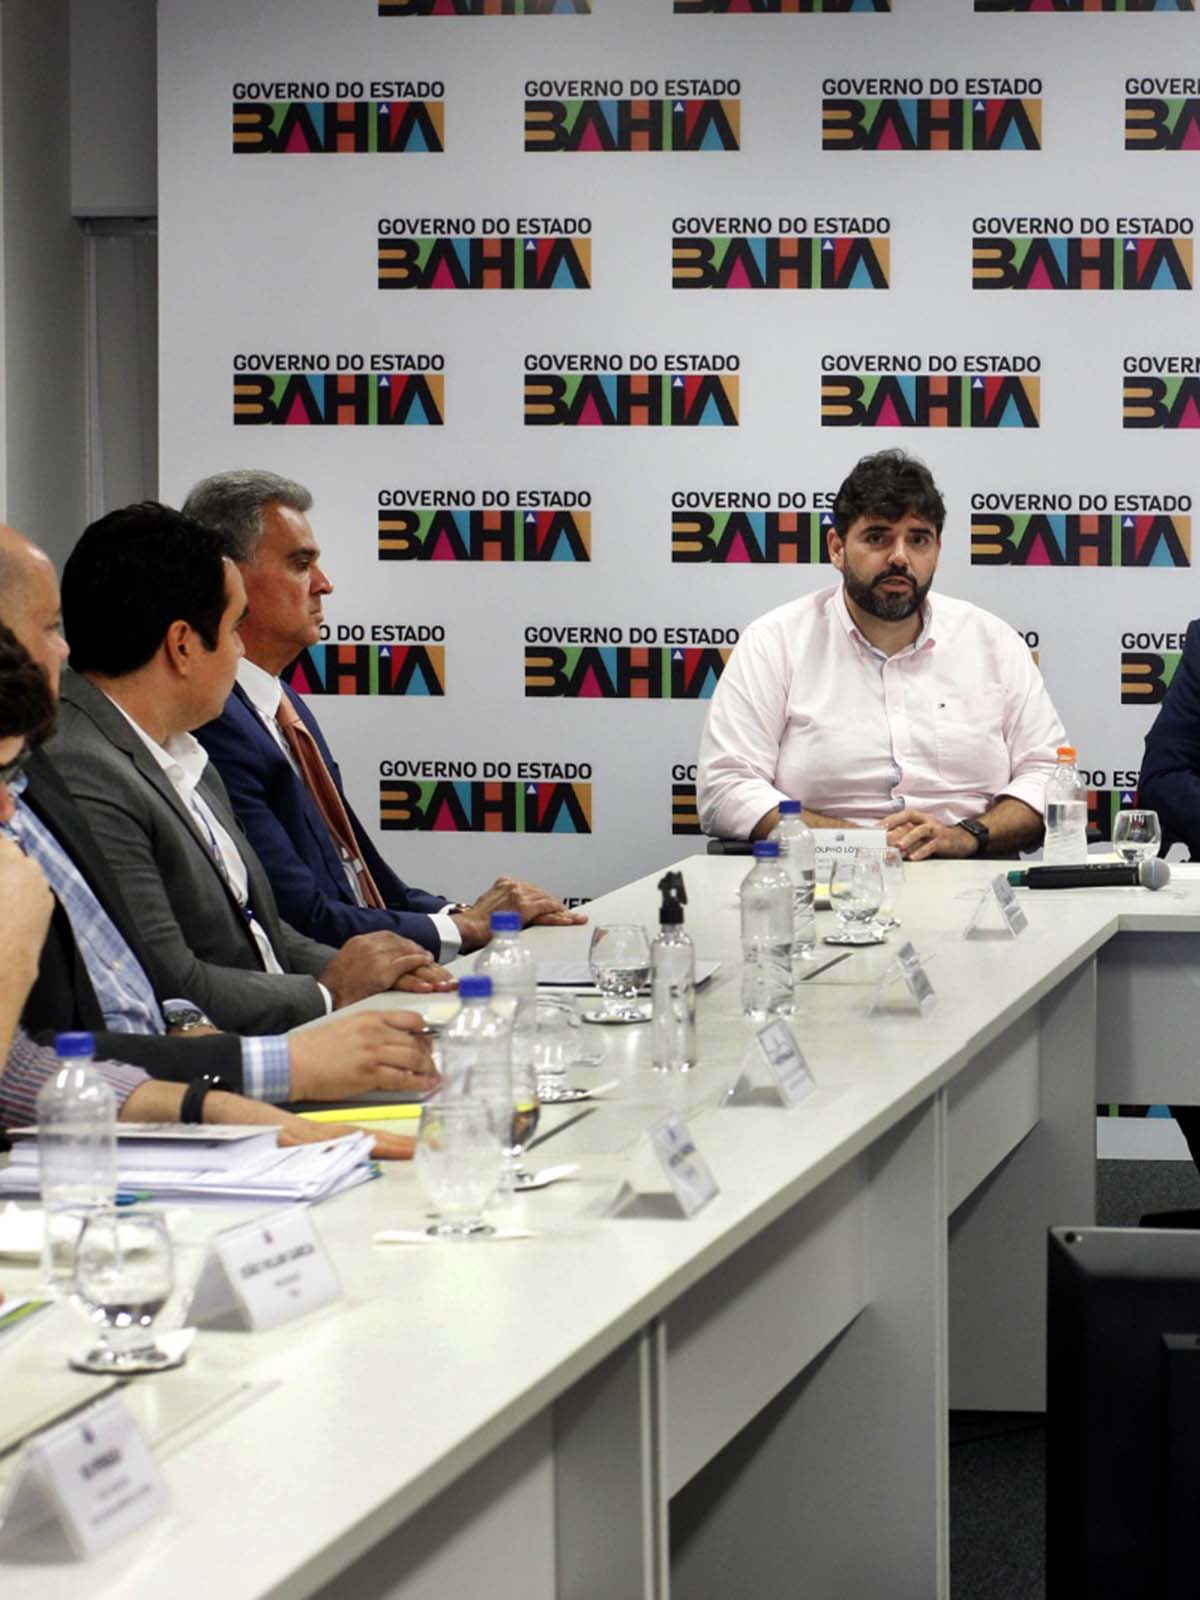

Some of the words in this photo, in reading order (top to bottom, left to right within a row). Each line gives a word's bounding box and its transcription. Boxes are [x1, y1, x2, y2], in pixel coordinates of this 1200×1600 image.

[232, 81, 330, 99] GOVERNO
[335, 81, 364, 99] DO
[370, 80, 445, 98] ESTADO
[524, 79, 624, 97] GOVERNO
[629, 79, 659, 97] DO
[664, 78, 741, 96] ESTADO
[821, 78, 924, 96] GOVERNO
[929, 77, 959, 95] DO
[965, 78, 1043, 96] ESTADO
[233, 101, 444, 153] BAHIA
[525, 99, 740, 152] BAHIA
[822, 98, 1041, 151] BAHIA
[377, 217, 476, 235] GOVERNO
[482, 217, 511, 235] DO
[516, 217, 592, 235] ESTADO
[671, 216, 773, 234] GOVERNO
[778, 217, 808, 235] DO
[813, 217, 891, 235] ESTADO
[972, 217, 1074, 235] GOVERNO
[1080, 217, 1110, 235] DO
[1116, 217, 1194, 235] ESTADO
[378, 237, 591, 290] BAHIA
[672, 237, 890, 290] BAHIA
[972, 237, 1193, 291] BAHIA
[233, 354, 331, 372] GOVERNO
[336, 354, 365, 372] DO
[370, 354, 445, 372] ESTADO
[523, 354, 623, 372] GOVERNO
[629, 354, 658, 372] DO
[664, 354, 740, 372] ESTADO
[821, 354, 922, 372] GOVERNO
[928, 355, 958, 373] DO
[963, 355, 1041, 373] ESTADO
[233, 373, 444, 426] BAHIA
[524, 374, 739, 427] BAHIA
[821, 375, 1040, 428] BAHIA
[377, 489, 476, 507] GOVERNO
[482, 490, 510, 508] DO
[516, 490, 592, 508] ESTADO
[671, 491, 772, 509] GOVERNO
[777, 492, 807, 510] DO
[970, 493, 1073, 511] GOVERNO
[1078, 494, 1108, 512] DO
[1114, 494, 1192, 512] ESTADO
[378, 509, 591, 562] BAHIA
[672, 511, 835, 564] BAHI
[971, 514, 1191, 567] BAHIA
[337, 624, 365, 642] DO
[371, 624, 445, 642] ESTADO
[524, 626, 623, 644] GOVERNO
[629, 627, 658, 645] DO
[663, 627, 740, 645] ESTADO
[1121, 632, 1187, 651] GOVE
[282, 644, 446, 696] AHIA
[379, 760, 477, 778] GOVERNO
[482, 761, 512, 779] DO
[517, 762, 593, 780] ESTADO
[1078, 770, 1107, 788] DO
[380, 781, 592, 832] BAHIA
